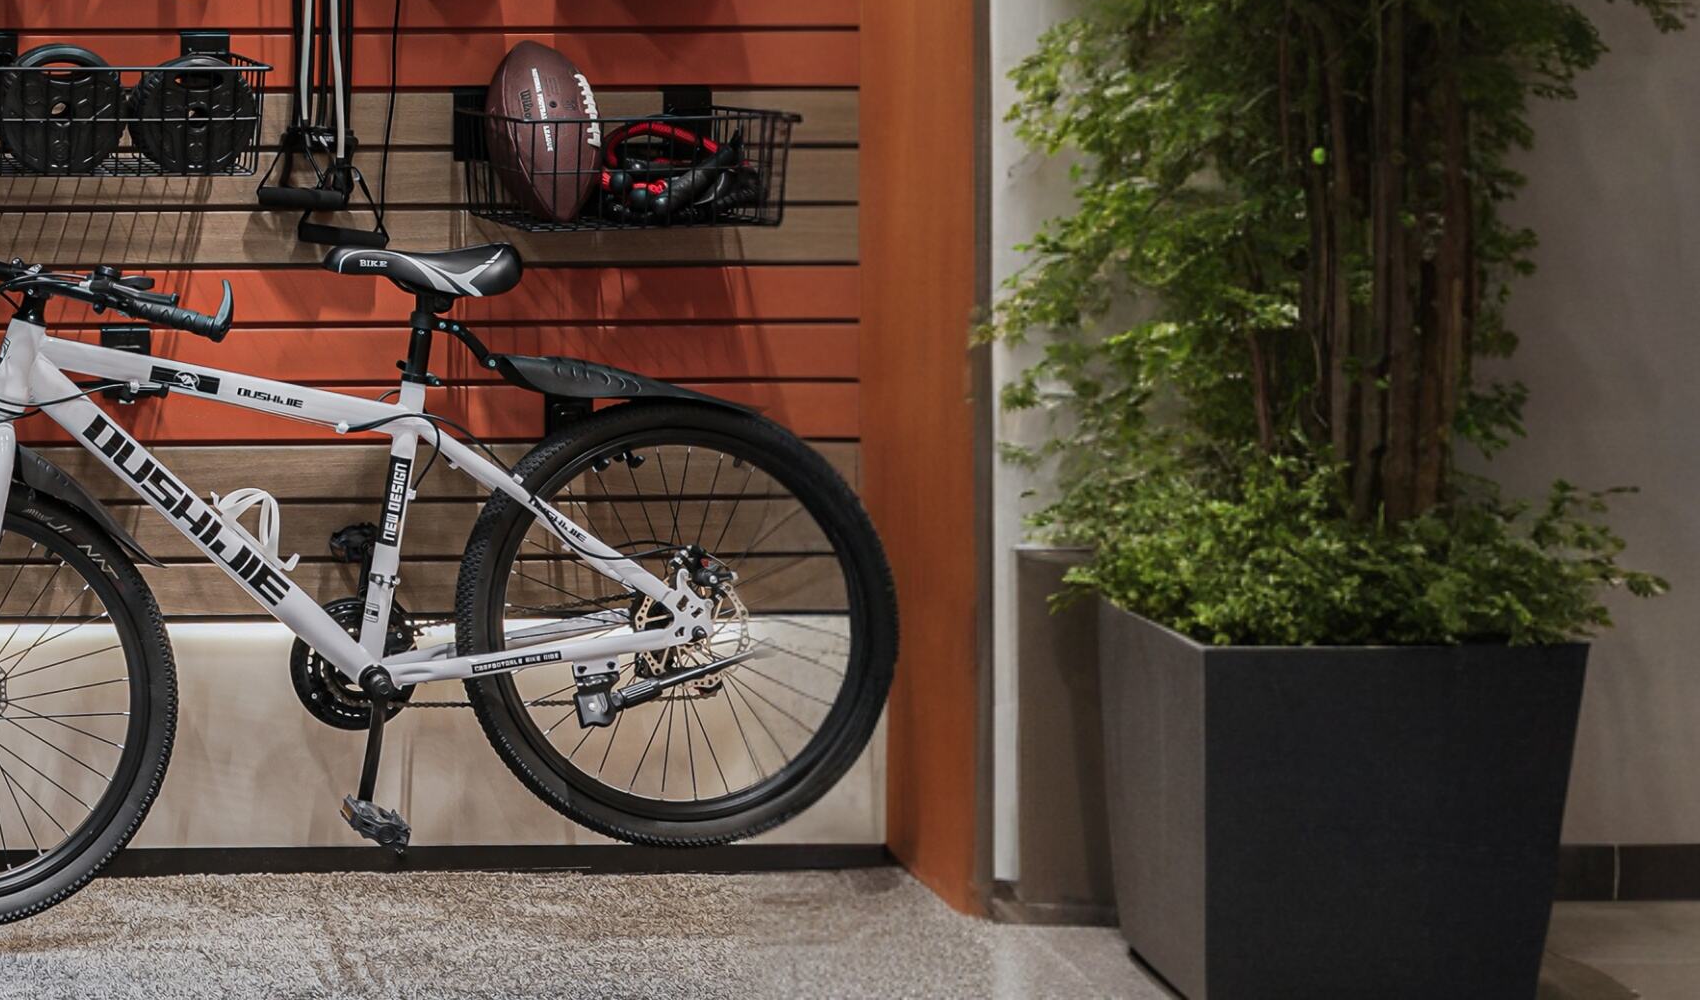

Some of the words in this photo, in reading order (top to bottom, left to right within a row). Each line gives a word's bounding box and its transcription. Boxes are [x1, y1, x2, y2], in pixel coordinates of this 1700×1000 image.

[360, 259, 388, 268] BIKE
[387, 462, 408, 512] DESIGN
[382, 513, 399, 541] NEW
